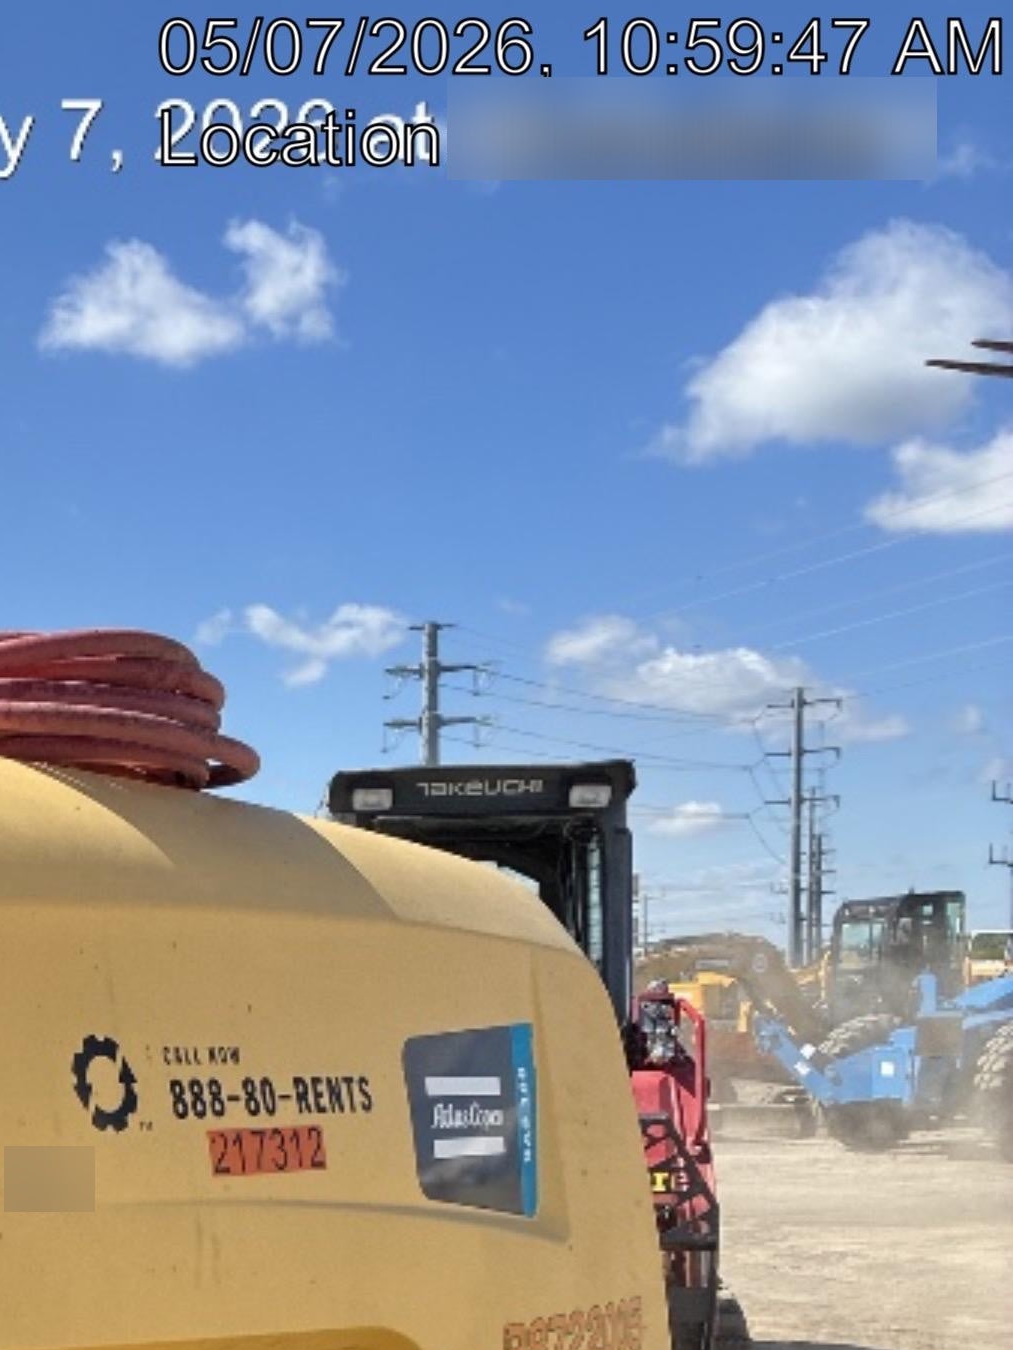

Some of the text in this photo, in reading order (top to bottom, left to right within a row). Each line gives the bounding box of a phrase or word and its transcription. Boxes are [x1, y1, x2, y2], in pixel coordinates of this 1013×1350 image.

[416, 779, 544, 797] TAKEUCHI
[169, 1075, 374, 1121] 888-80-RENTS
[210, 1127, 327, 1175] 217312
